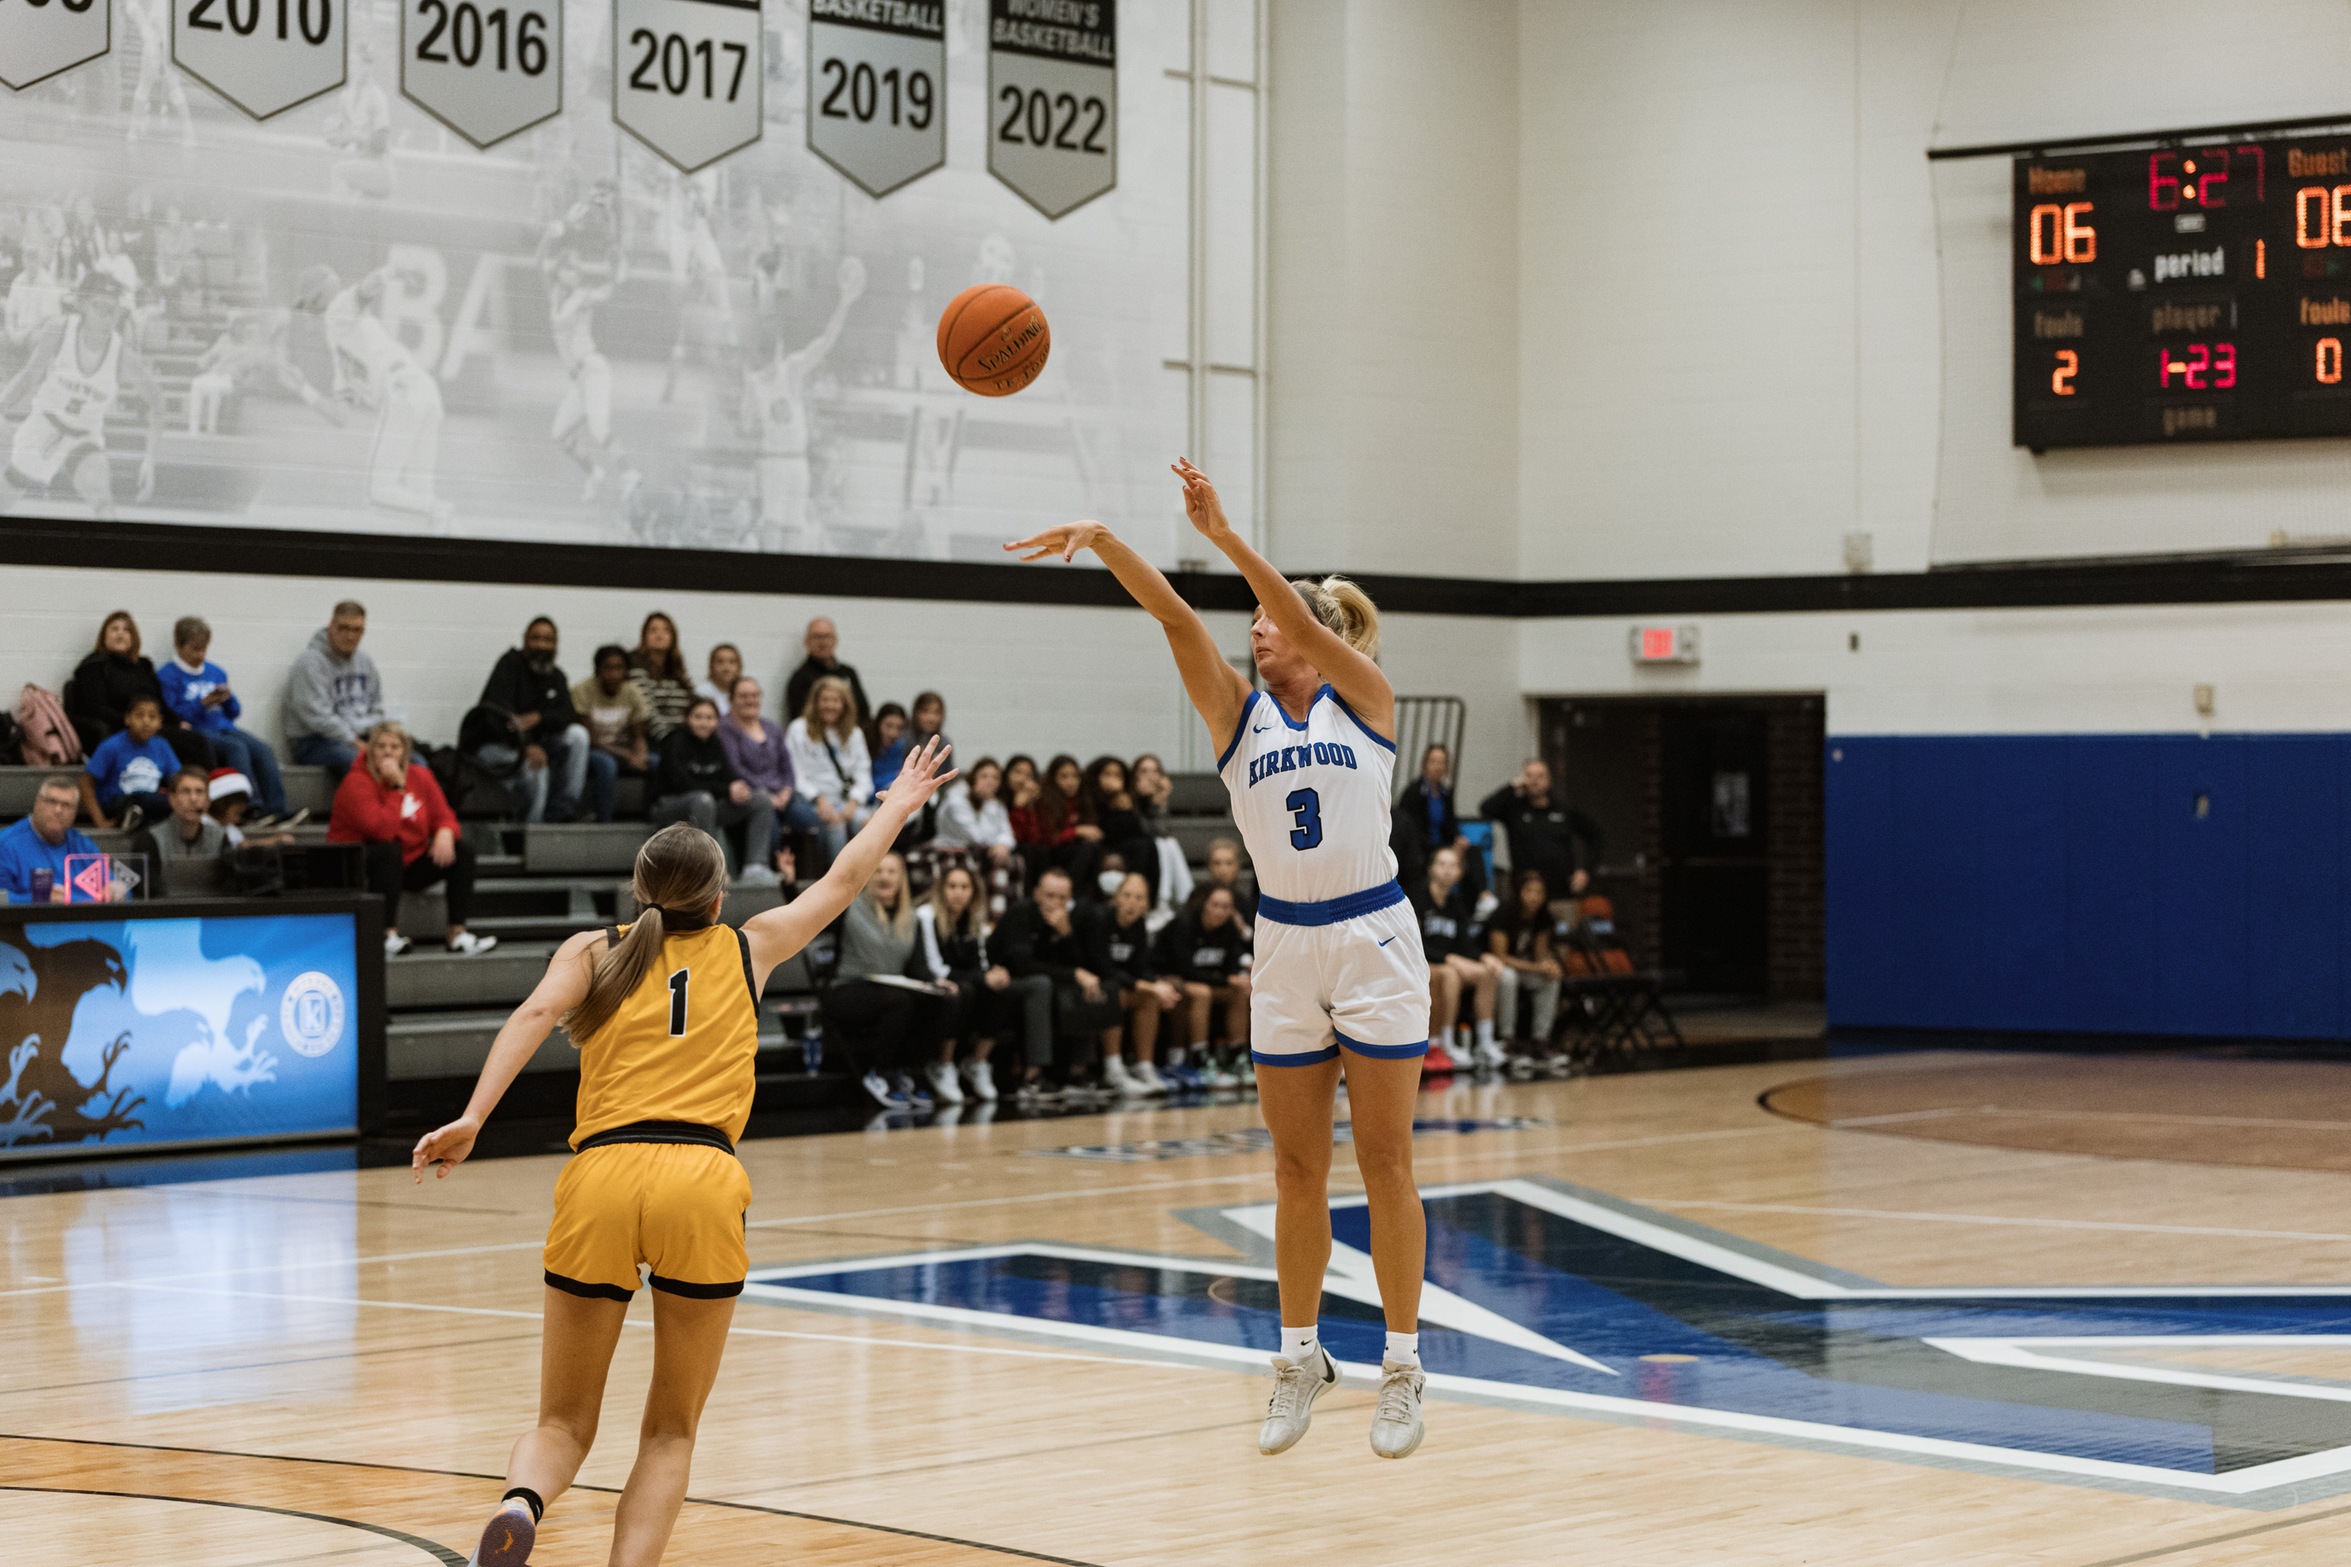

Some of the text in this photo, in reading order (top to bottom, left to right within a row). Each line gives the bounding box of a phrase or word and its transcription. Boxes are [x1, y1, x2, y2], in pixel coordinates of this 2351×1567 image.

[417, 0, 547, 76] 2016
[992, 17, 1112, 59] BASKETBALL
[1007, 0, 1099, 28] WOMEN'S
[629, 28, 747, 102] 2017
[822, 58, 933, 131] 2019
[1000, 85, 1107, 154] 2022
[2150, 145, 2265, 212] 6:27
[2030, 201, 2097, 265] 06
[2256, 239, 2266, 279] 1
[2155, 246, 2225, 283] period
[977, 315, 1045, 374] SPALDING
[2052, 350, 2079, 395] 2
[2315, 337, 2342, 384] 0
[1249, 741, 1357, 789] KIRKWOOD
[1286, 787, 1323, 851] 3
[668, 967, 690, 1037] 1
